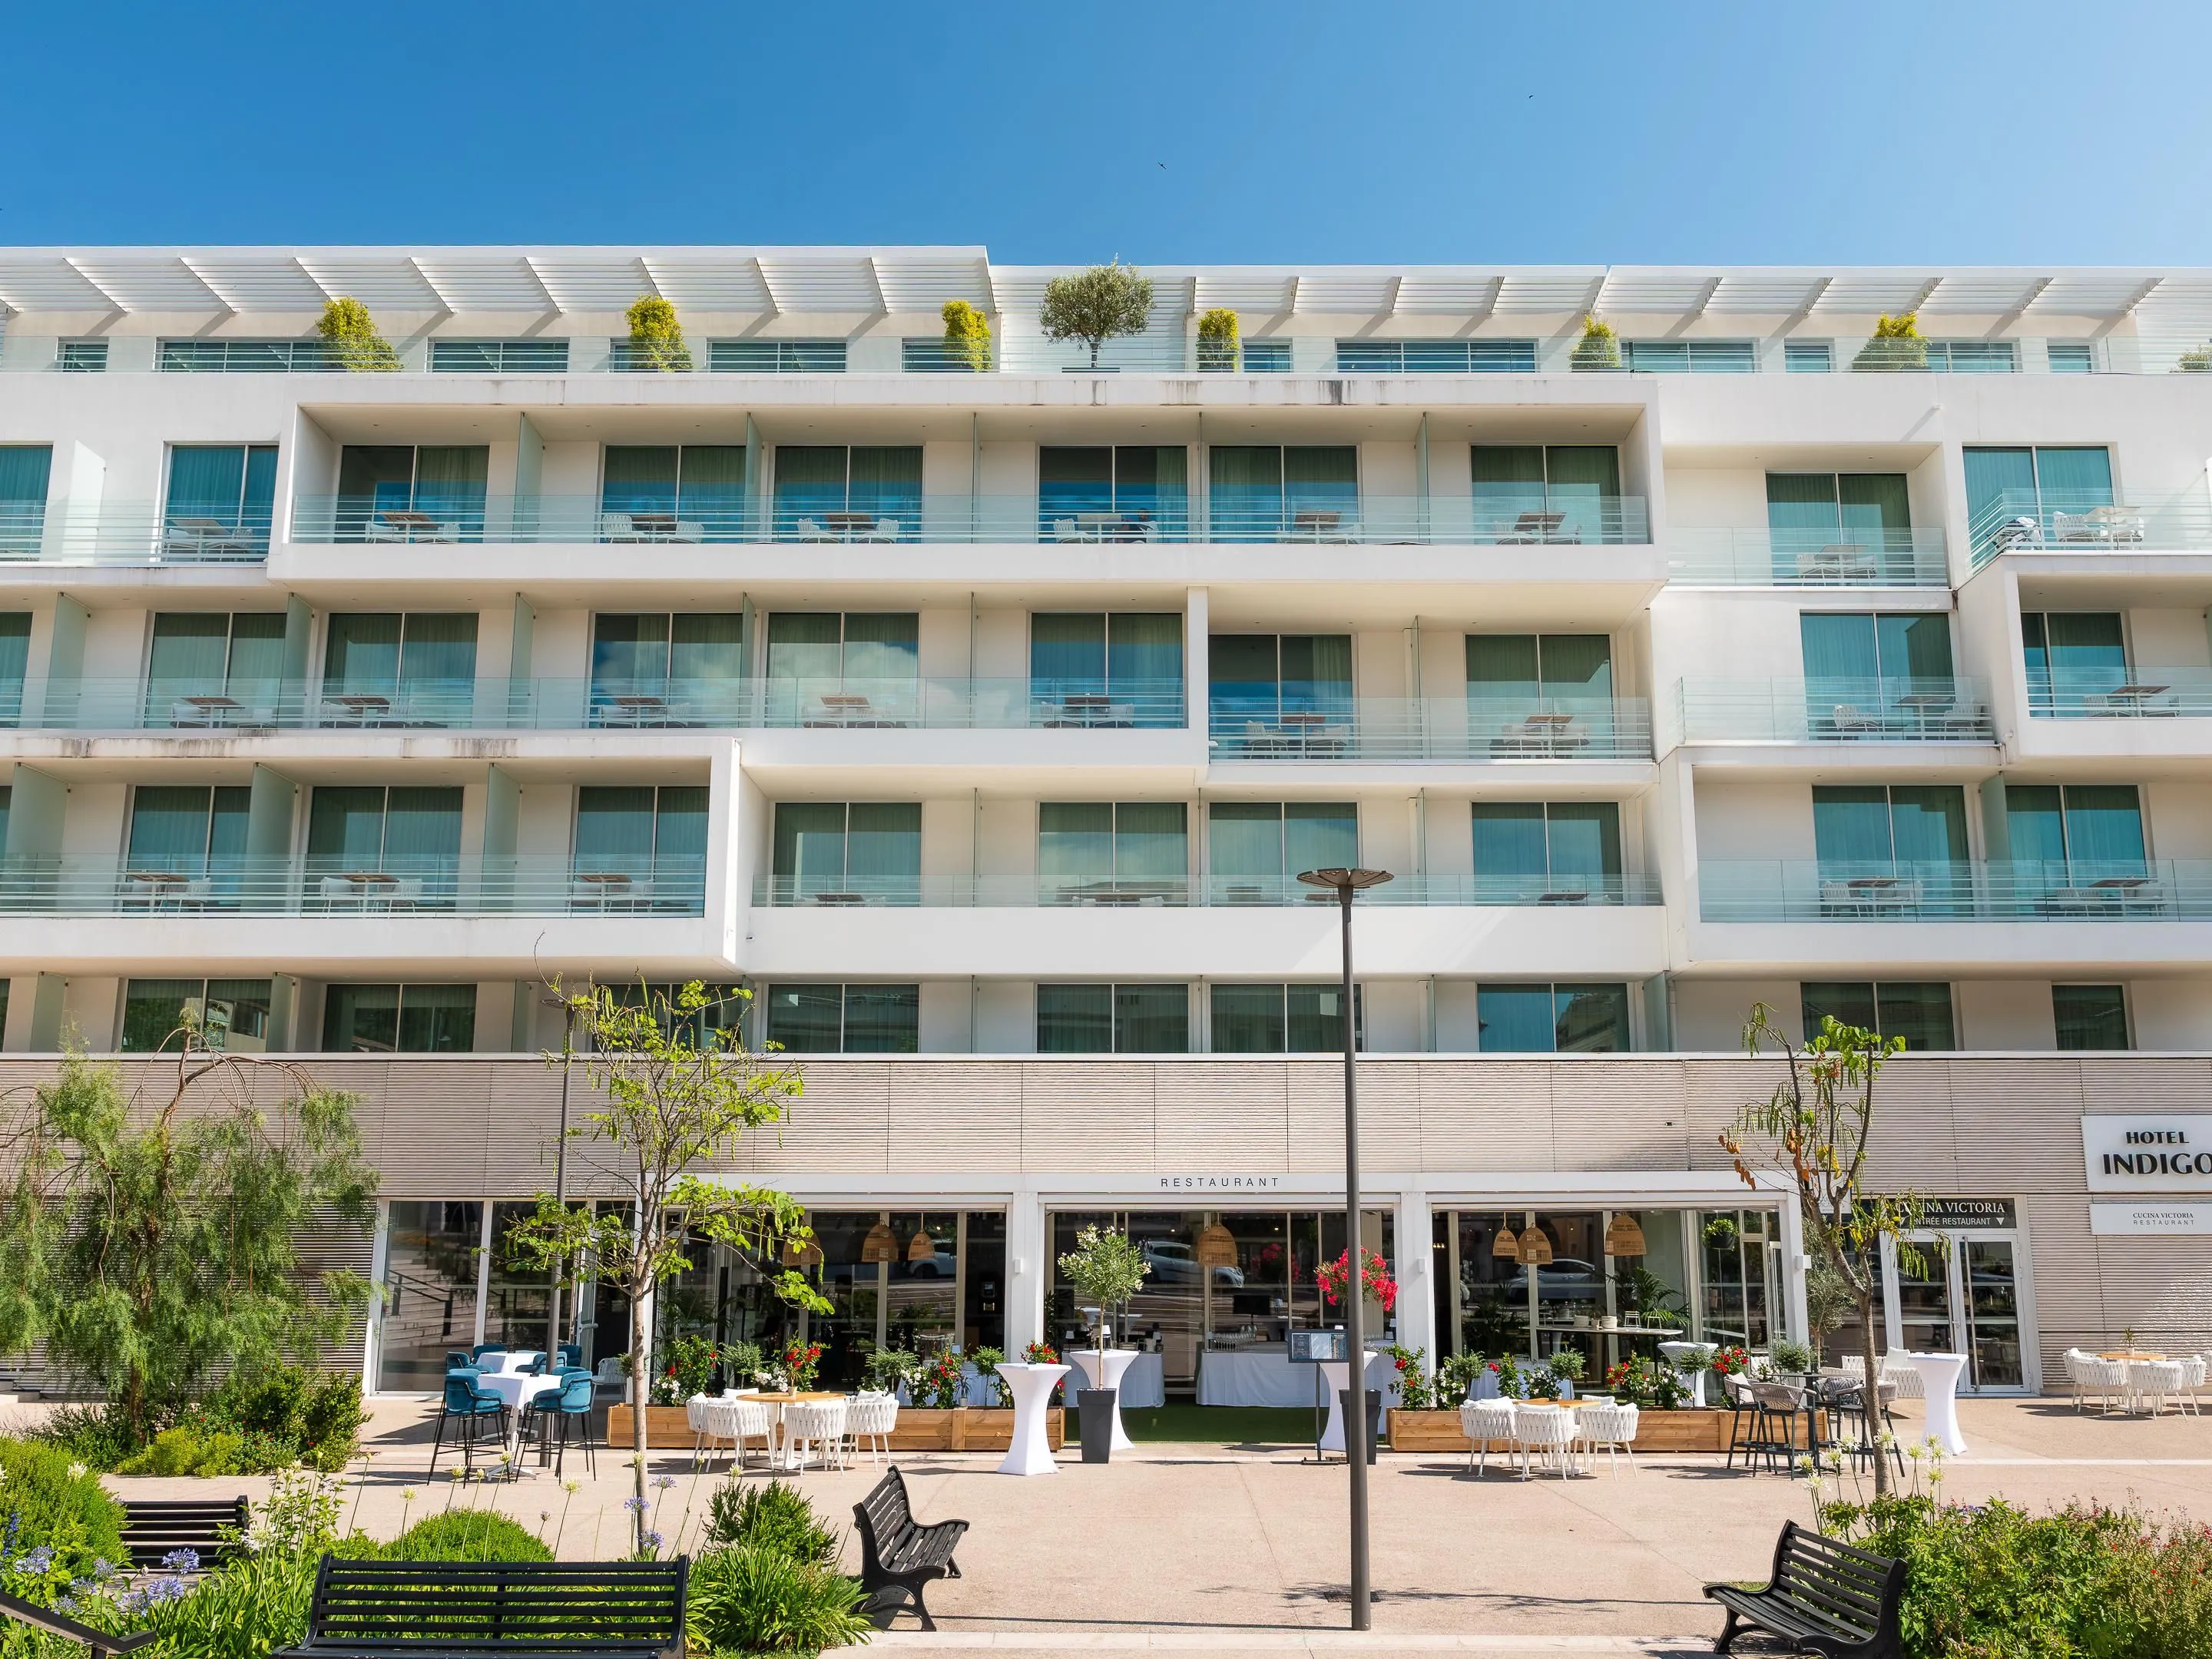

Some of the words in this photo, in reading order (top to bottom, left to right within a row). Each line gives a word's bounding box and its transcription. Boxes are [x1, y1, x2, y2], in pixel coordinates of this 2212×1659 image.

[2125, 1131, 2190, 1144] HOTEL
[2102, 1152, 2212, 1175] INDIGO
[1161, 1177, 1279, 1187] RESTAURANT
[1945, 1202, 2005, 1214] VICTORIA
[1912, 1216, 1940, 1226] NTRÉE
[1942, 1217, 1992, 1226] RESTAURANT
